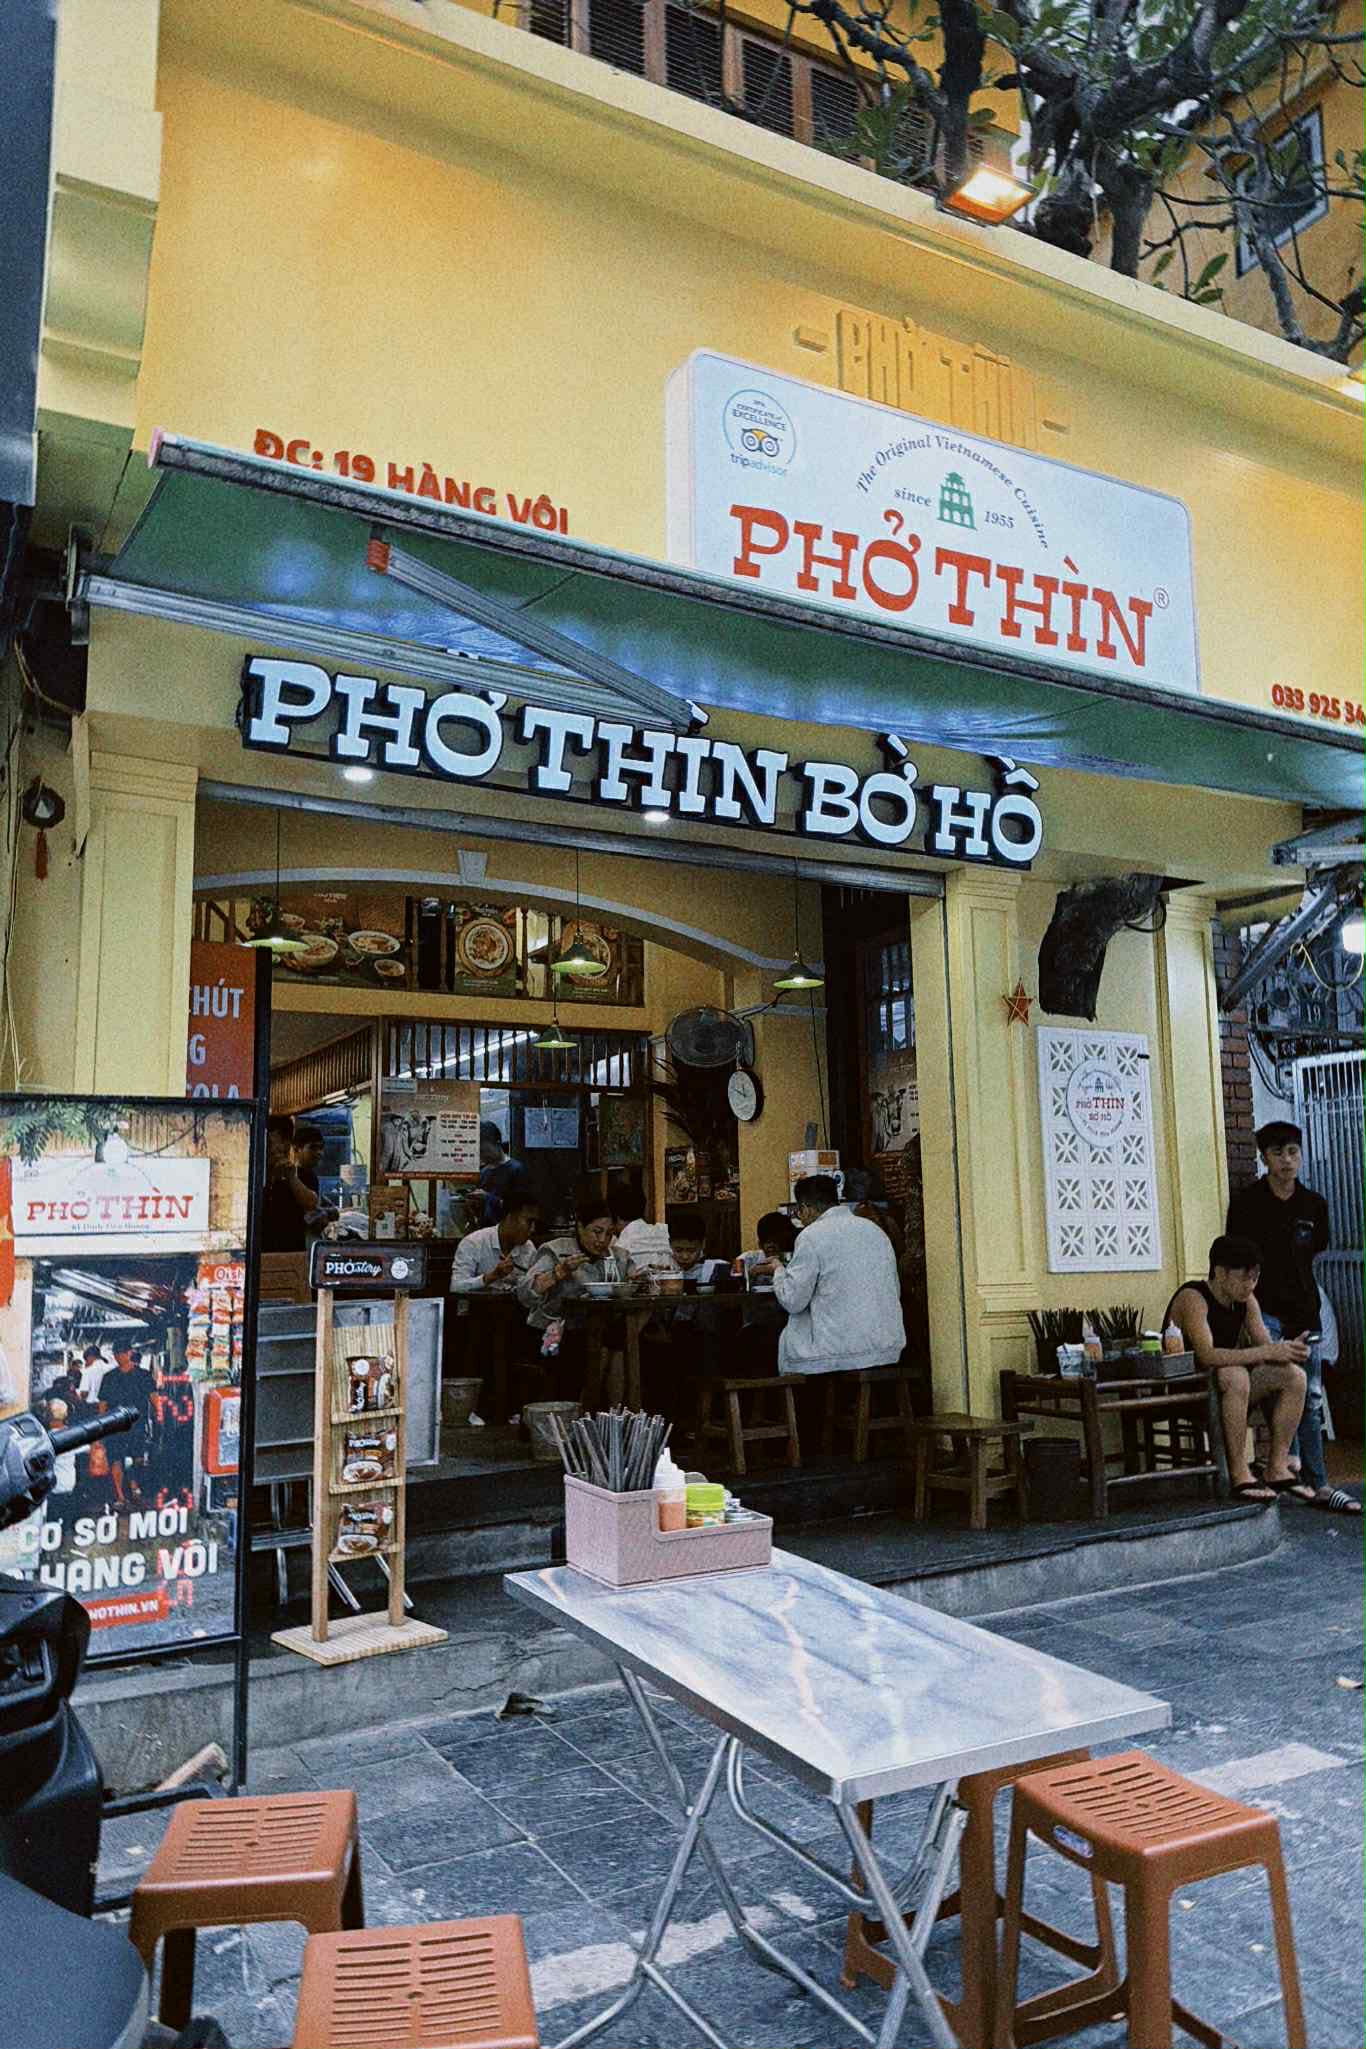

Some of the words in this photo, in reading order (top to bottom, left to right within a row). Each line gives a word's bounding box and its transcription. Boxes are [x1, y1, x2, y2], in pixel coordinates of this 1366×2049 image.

[732, 409, 786, 431] EXCELLENCE
[254, 429, 324, 470] ĐC:
[334, 450, 376, 484] 19
[387, 462, 498, 516] HÀNG
[506, 492, 569, 535] VÔI
[730, 453, 789, 477] tripadvisor
[857, 465, 877, 493] The
[875, 434, 931, 467] Original
[936, 434, 1013, 487] Vietnamese
[1014, 487, 1049, 550] Cuisine
[894, 487, 932, 507] since
[984, 511, 1015, 529] 1955
[730, 503, 921, 612] PHỞ
[935, 546, 1153, 667] THÌN
[1271, 683, 1305, 711] 033
[1309, 692, 1341, 719] 925
[803, 733, 919, 845] BỜ
[932, 755, 1044, 863] HỒ
[27, 1191, 92, 1221] PHỞ
[96, 1186, 194, 1220] THÌN
[20, 1518, 64, 1551] CƠ
[74, 1503, 119, 1546] SỞ
[129, 1498, 189, 1541] MỚI
[159, 1538, 218, 1581] VÔI
